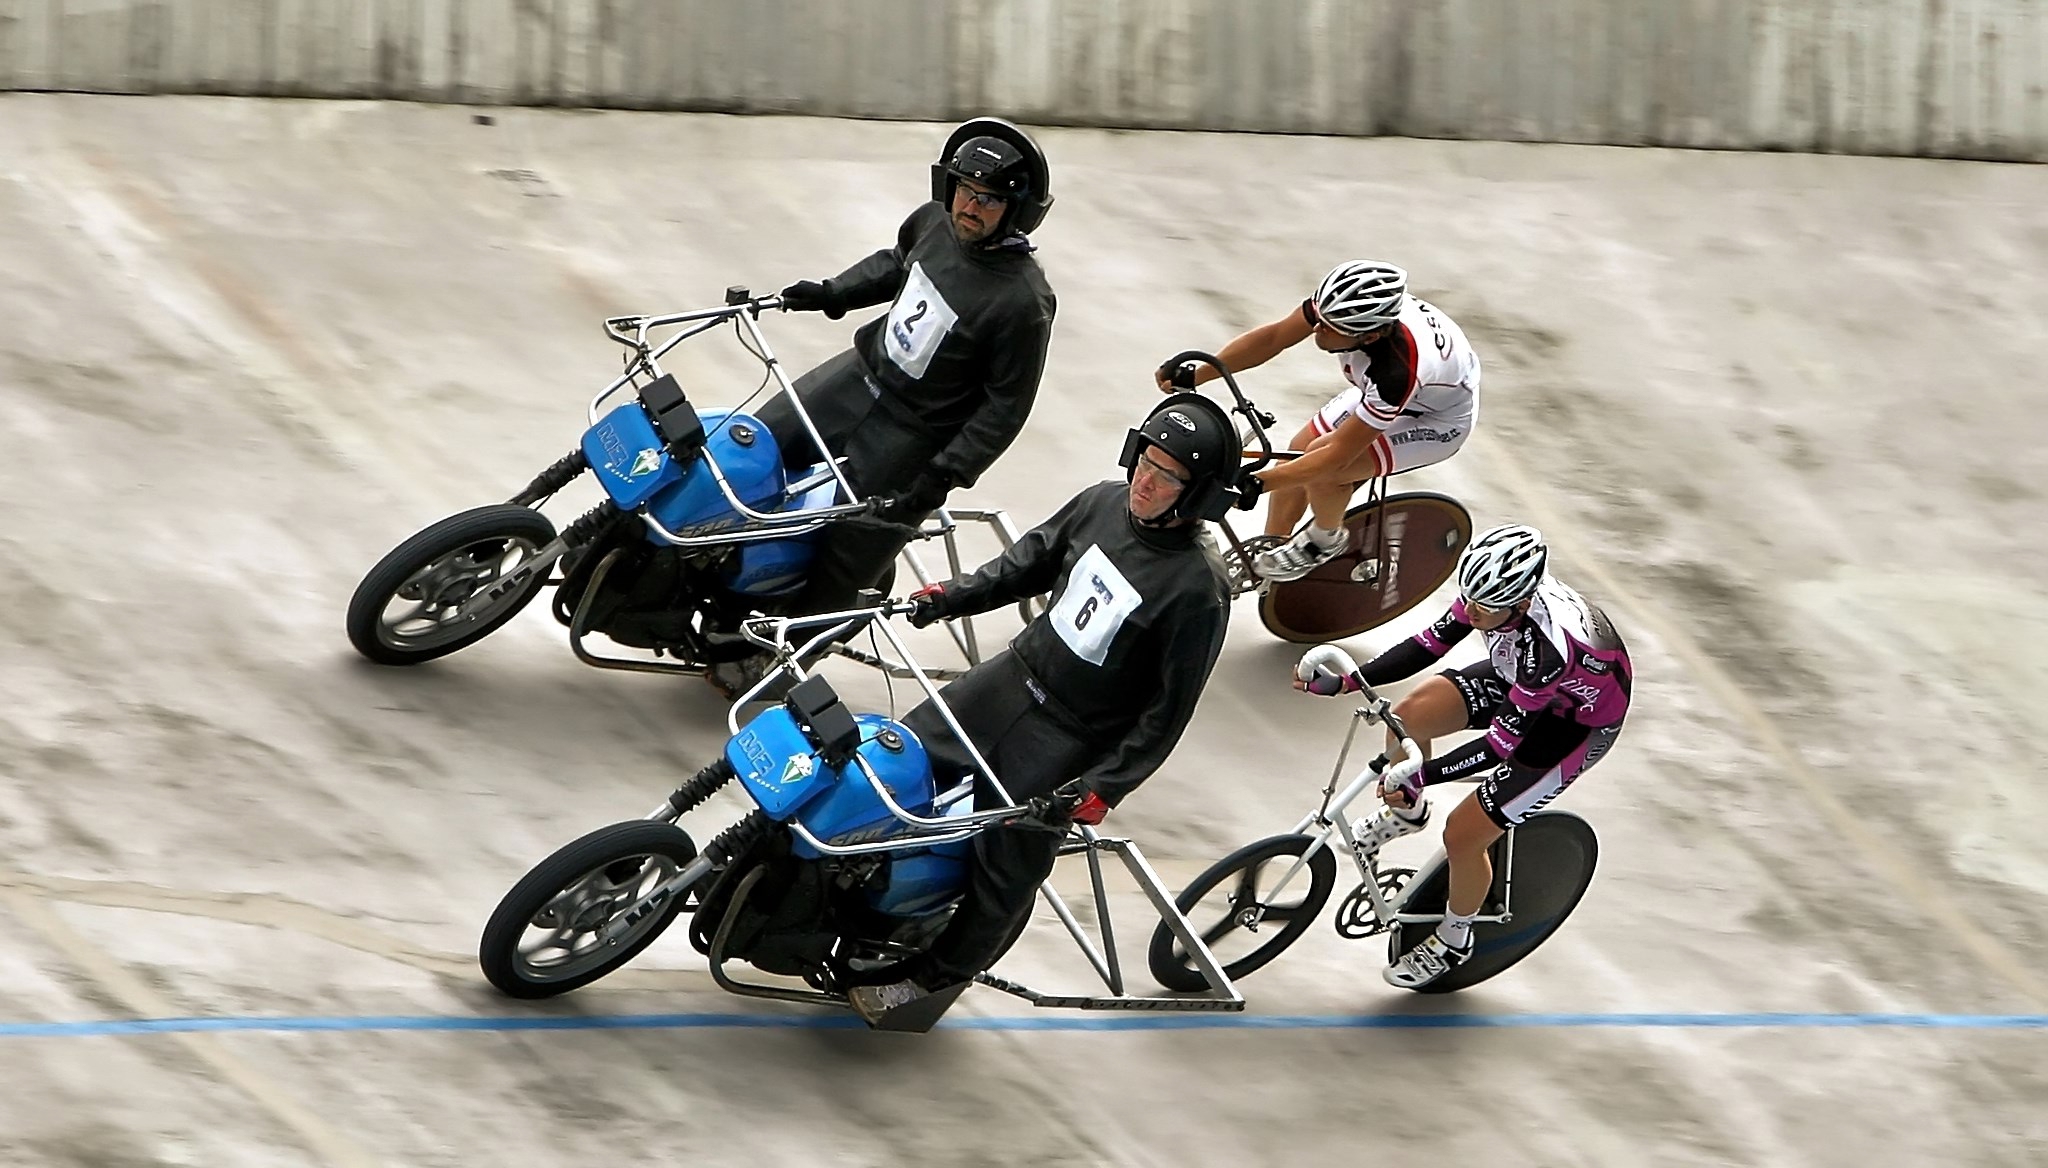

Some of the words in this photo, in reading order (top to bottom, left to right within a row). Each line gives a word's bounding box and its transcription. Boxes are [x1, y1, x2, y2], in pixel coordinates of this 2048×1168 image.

[904, 300, 927, 333] 2
[489, 567, 533, 601] MZ
[1075, 596, 1098, 631] 6
[624, 888, 669, 927] MZ
